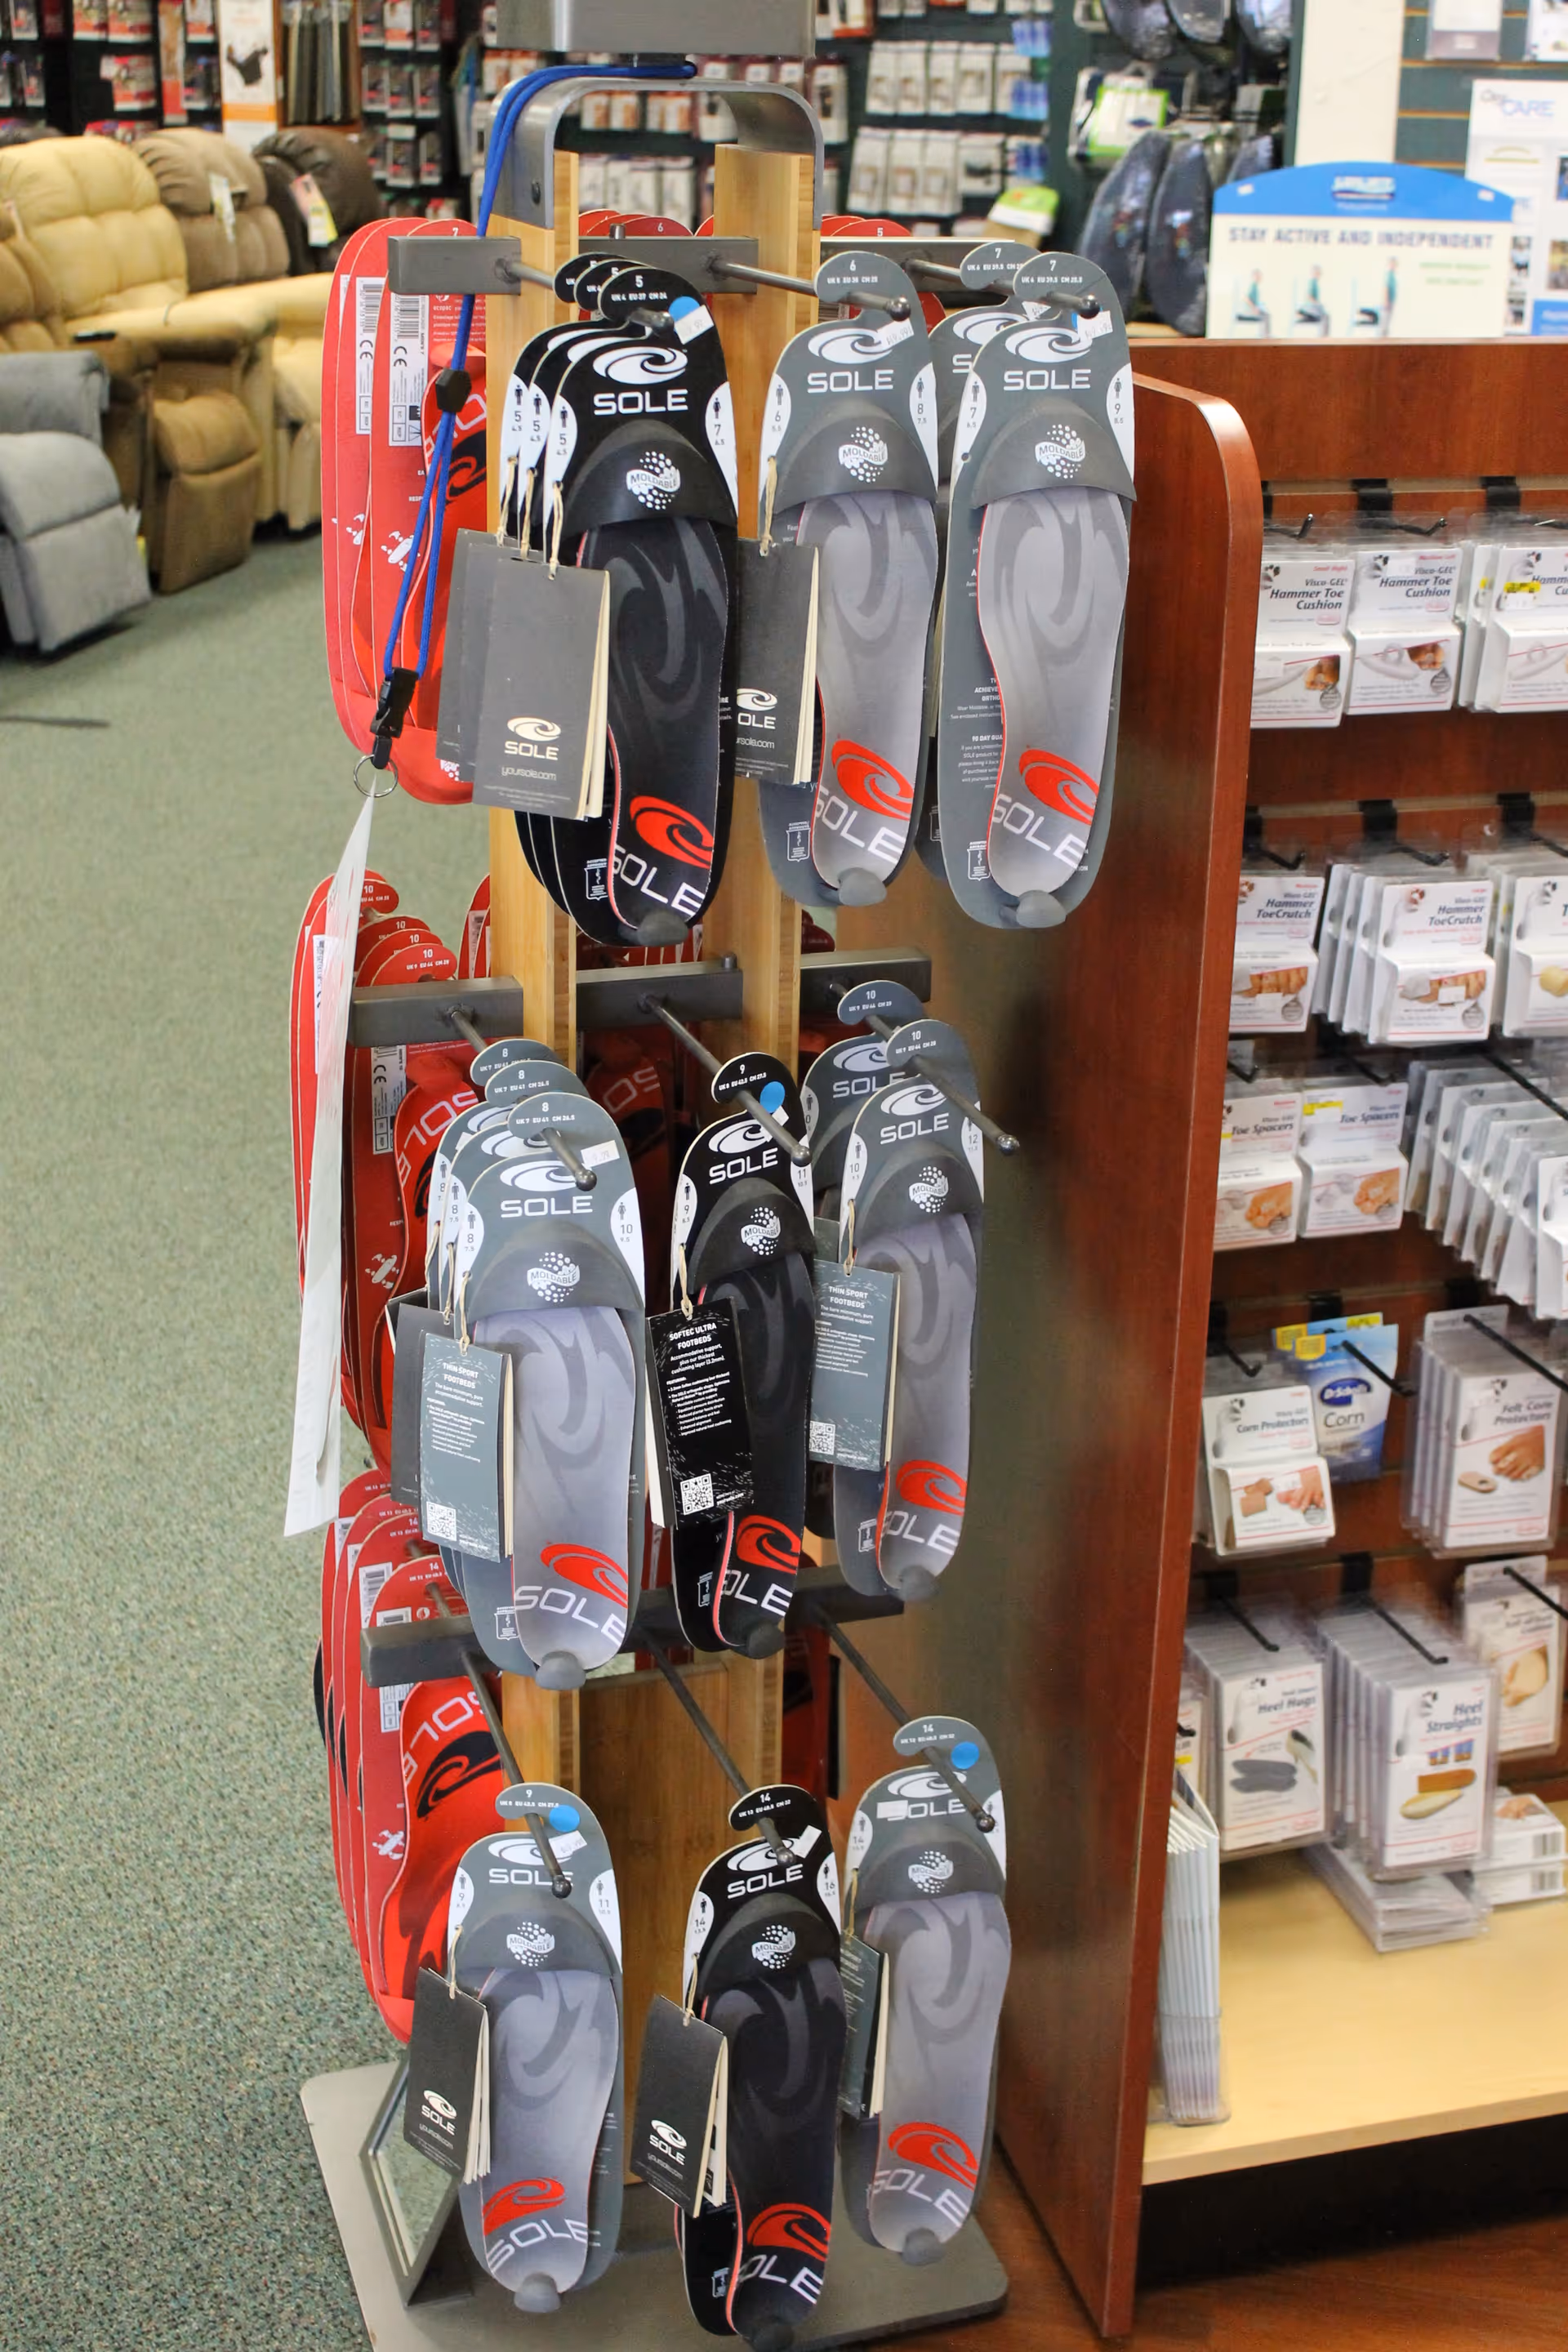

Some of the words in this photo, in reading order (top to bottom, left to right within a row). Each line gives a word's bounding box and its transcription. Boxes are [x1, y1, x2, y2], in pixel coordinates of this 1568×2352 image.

[657, 222, 664, 233] 6
[876, 227, 883, 237] 5
[1229, 226, 1268, 243] STAY
[1274, 228, 1330, 245] ACTIVE
[1338, 229, 1372, 246] AND
[1377, 230, 1494, 250] INDEPENDENT
[995, 247, 1001, 258] 7
[849, 260, 857, 271] 6
[1049, 260, 1057, 272] 7
[635, 275, 644, 287] 5
[807, 369, 894, 394] SOLE
[1003, 369, 1092, 391] SOLE
[594, 389, 688, 416] SOLE
[917, 403, 924, 415] 8
[970, 407, 977, 418] 7
[1114, 403, 1121, 415] 9
[774, 410, 782, 422] 6
[532, 421, 540, 432] 5
[714, 424, 721, 436] 7
[559, 434, 567, 446] 5
[842, 447, 885, 462] MOLDABLE
[1038, 444, 1085, 460] MOLDABLE
[630, 472, 679, 490] MOLDABLE
[1379, 576, 1431, 588] Hammer
[1432, 576, 1452, 586] Toe
[1269, 588, 1323, 599] Hammer
[1324, 588, 1345, 599] Toe
[1405, 586, 1451, 598] Cushion
[1296, 599, 1343, 611] Cushion
[737, 712, 777, 729] OLE
[736, 737, 775, 749] rsole.com
[504, 740, 559, 761] SOLE
[501, 765, 557, 782] yoursole.com
[364, 885, 374, 893] 10
[1266, 898, 1314, 909] Hammer
[1437, 903, 1485, 915] Hammer
[1256, 908, 1312, 920] ToeCrutch
[396, 920, 406, 929] 10
[1428, 915, 1483, 926] ToeCrutch
[409, 934, 420, 943] 10
[423, 949, 434, 959] 10
[866, 991, 876, 1000] 10
[911, 1031, 921, 1040] 10
[502, 1048, 509, 1058] 8
[518, 1070, 525, 1080] 8
[739, 1064, 746, 1075] 9
[832, 1071, 906, 1098] SOLE
[541, 1102, 549, 1112] 8
[1340, 1114, 1358, 1124] Toe
[1360, 1111, 1401, 1125] Spacers
[880, 1112, 950, 1145] SOLE
[1232, 1125, 1250, 1135] Toe
[1252, 1121, 1294, 1135] Spacers
[968, 1134, 978, 1144] 12
[709, 1147, 778, 1185] SOLE
[849, 1163, 860, 1173] 10
[797, 1168, 807, 1180] 11
[452, 1205, 458, 1215] 8
[501, 1195, 594, 1218] SOLE
[684, 1205, 690, 1215] 9
[620, 1223, 633, 1235] 10
[744, 1225, 780, 1237] MOLDABLE
[466, 1233, 474, 1244] 8
[531, 1271, 577, 1285] MOLDABLE
[828, 1285, 844, 1296] THIN
[845, 1289, 869, 1299] SPORT
[830, 1296, 866, 1309] FOOTBEDS
[669, 1326, 695, 1341] SOFTEC
[694, 1322, 717, 1334] ULTRA
[677, 1335, 712, 1350] FOOTBEDS
[670, 1348, 703, 1361] Accommodative
[442, 1362, 458, 1374] THIN
[457, 1365, 479, 1379] SPORT
[443, 1373, 476, 1389] FOOTBEDS
[1503, 1401, 1523, 1414] Felt
[1526, 1399, 1552, 1411] Corn
[1324, 1411, 1365, 1429] Corn
[1494, 1412, 1552, 1426] Protectors
[1237, 1423, 1260, 1434] Corn
[430, 1562, 439, 1571] 14
[721, 1569, 794, 1617] OLE
[514, 1585, 628, 1646] SOLE
[1258, 1702, 1287, 1715] Heel
[1454, 1701, 1485, 1717] Heel
[923, 1724, 934, 1733] 14
[1426, 1715, 1482, 1734] Straights
[526, 1789, 532, 1798] 9
[760, 1793, 771, 1803] 14
[887, 1798, 966, 1821] OLE
[727, 1863, 804, 1900] SOLE
[825, 1881, 835, 1891] 16
[458, 1892, 465, 1901] 9
[599, 1898, 609, 1908] 11
[694, 1918, 706, 1928] 14
[509, 1936, 552, 1952] MOLDABLE
[421, 2105, 457, 2137] SOLE
[648, 2133, 687, 2167] SOLE
[487, 2217, 589, 2277] SOLE
